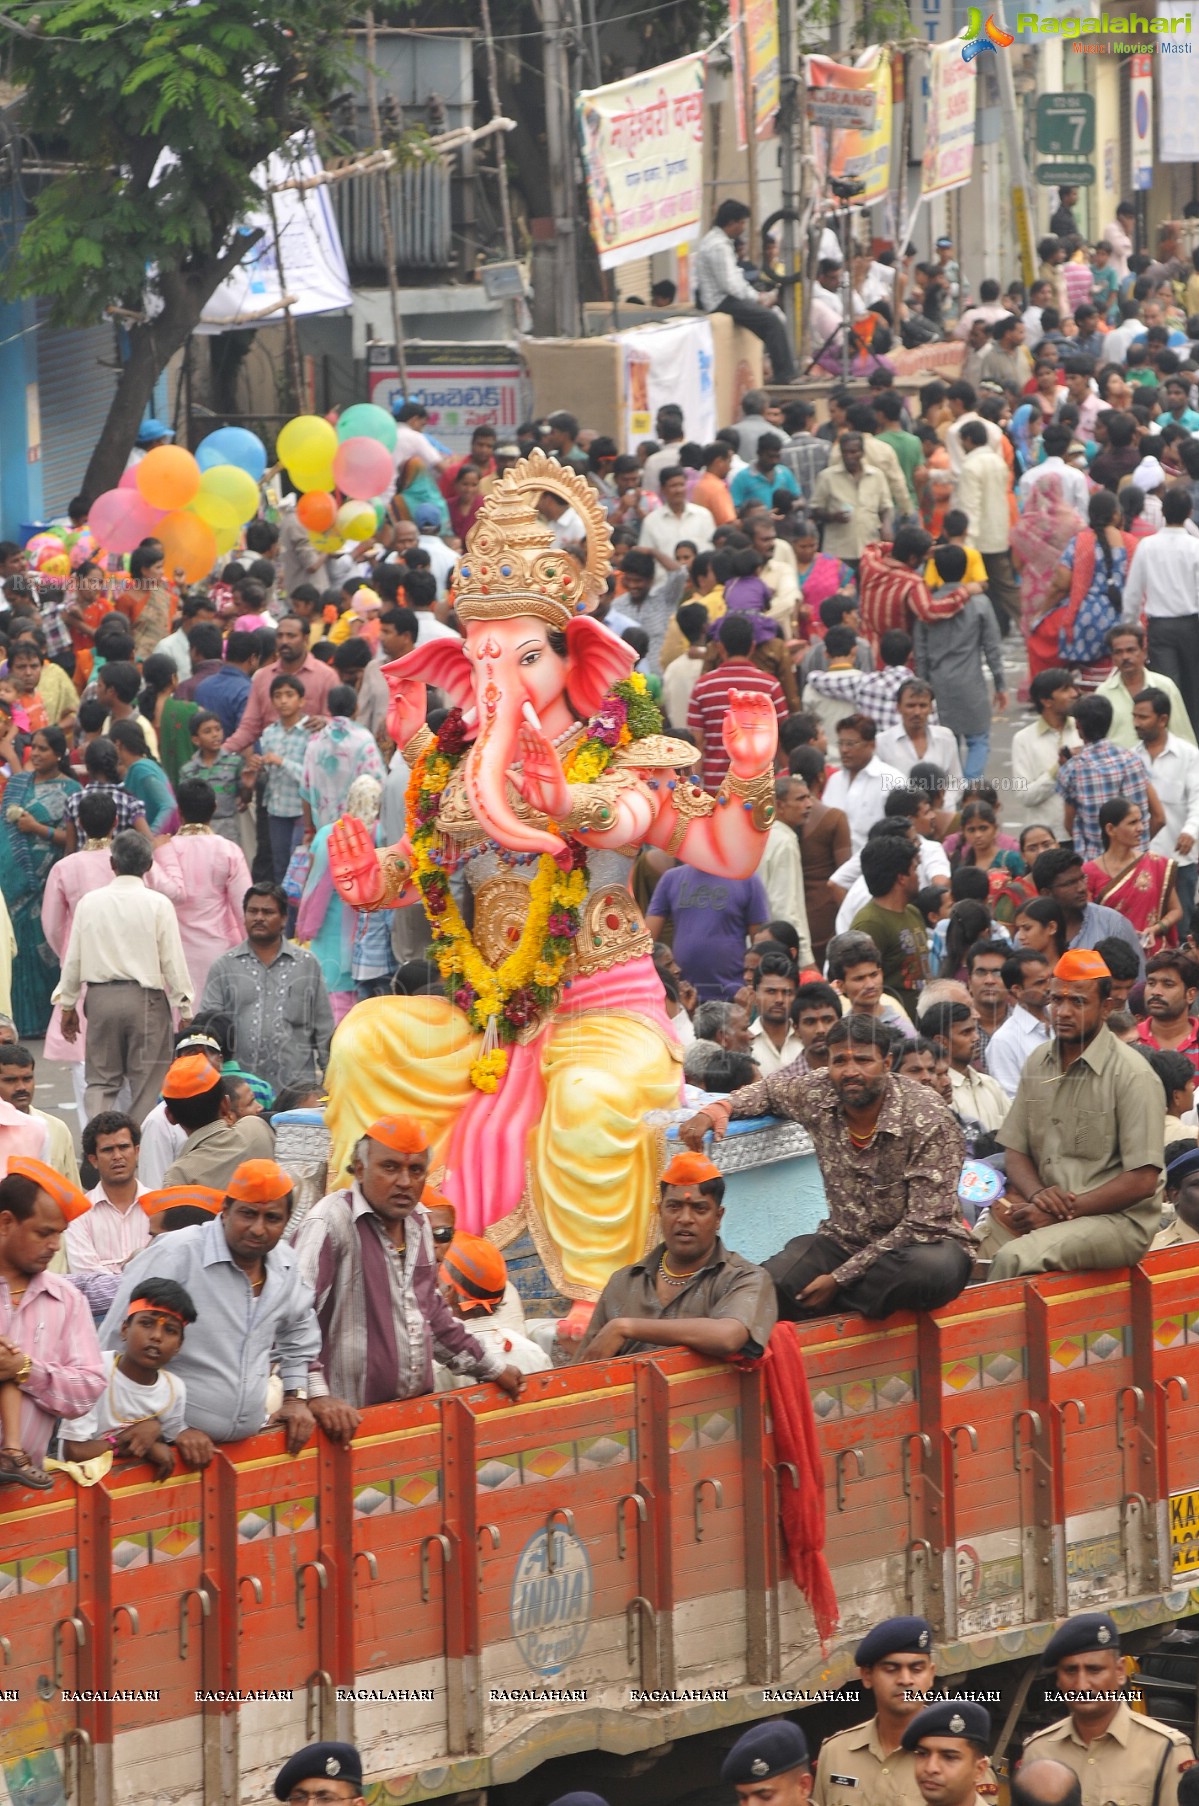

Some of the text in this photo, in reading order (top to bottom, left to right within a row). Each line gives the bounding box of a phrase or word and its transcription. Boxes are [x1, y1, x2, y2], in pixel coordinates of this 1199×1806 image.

[1068, 116, 1086, 151] 7
[678, 881, 729, 911] Lee
[517, 1571, 585, 1632] INDIA
